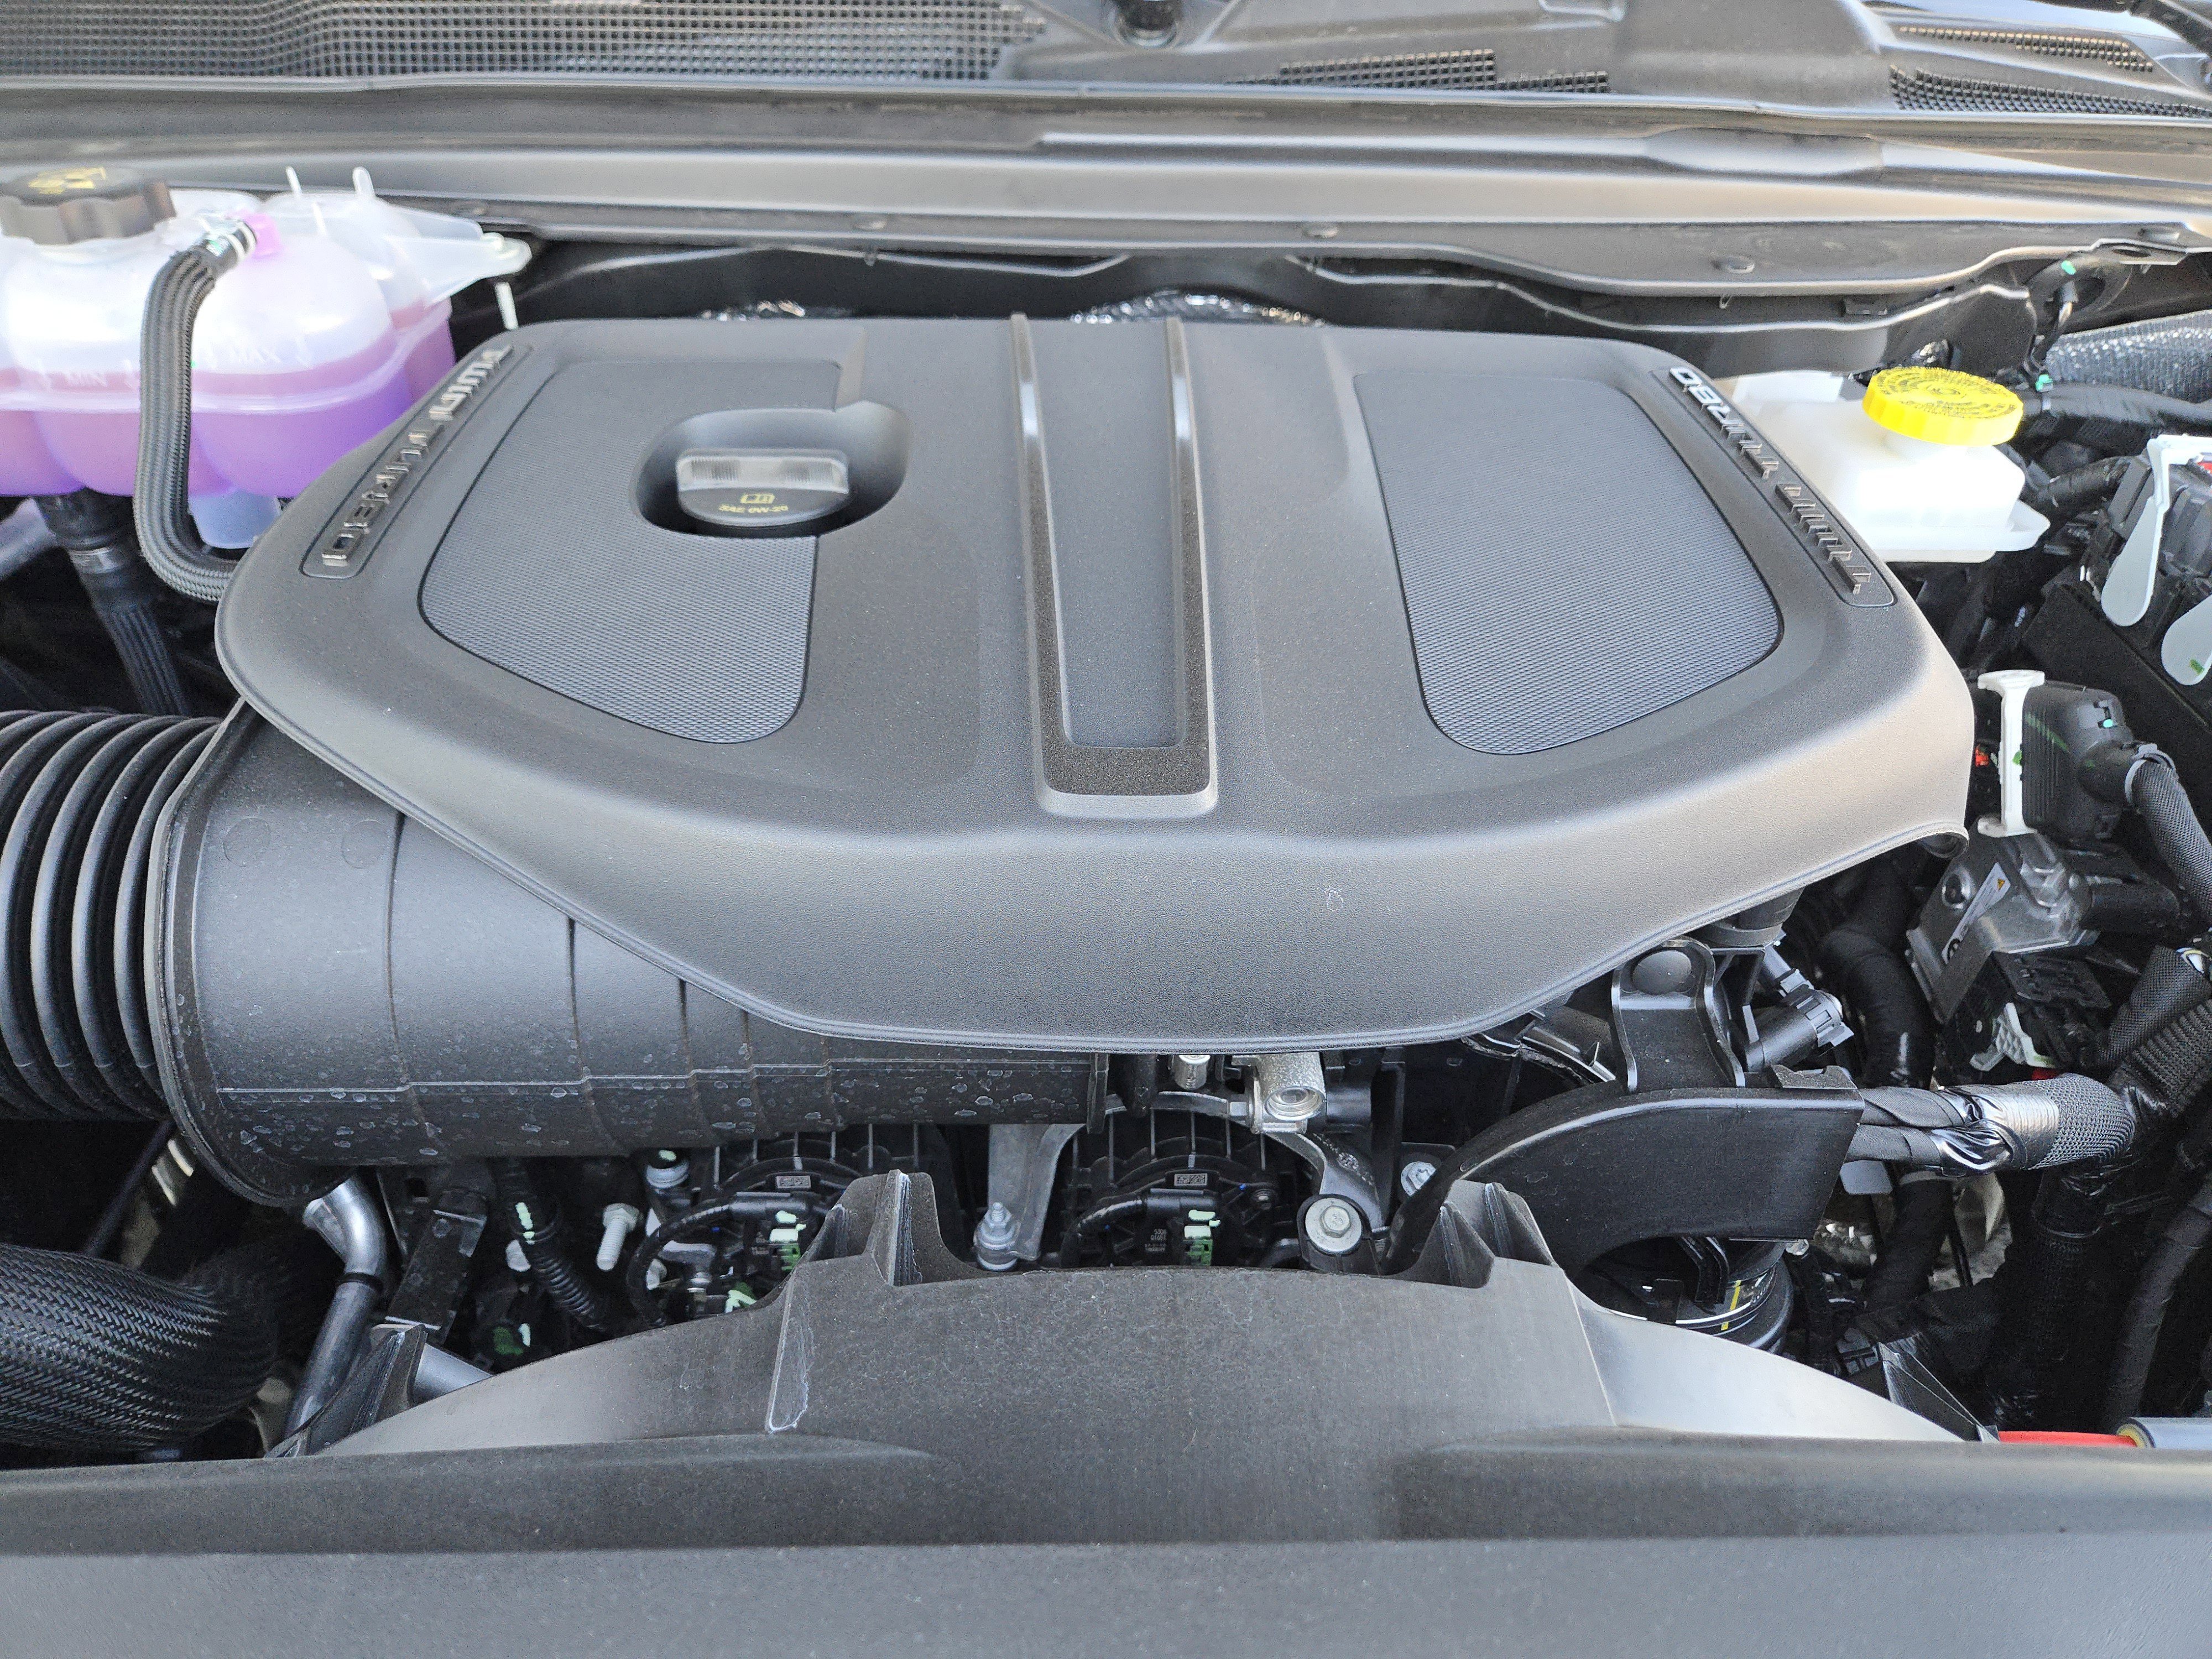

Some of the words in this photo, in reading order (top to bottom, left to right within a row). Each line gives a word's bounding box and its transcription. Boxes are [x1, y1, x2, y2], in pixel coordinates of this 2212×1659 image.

[231, 348, 283, 365] MAX
[64, 372, 107, 387] MIN
[1669, 367, 1780, 478] TURBO
[718, 504, 745, 513] SAE
